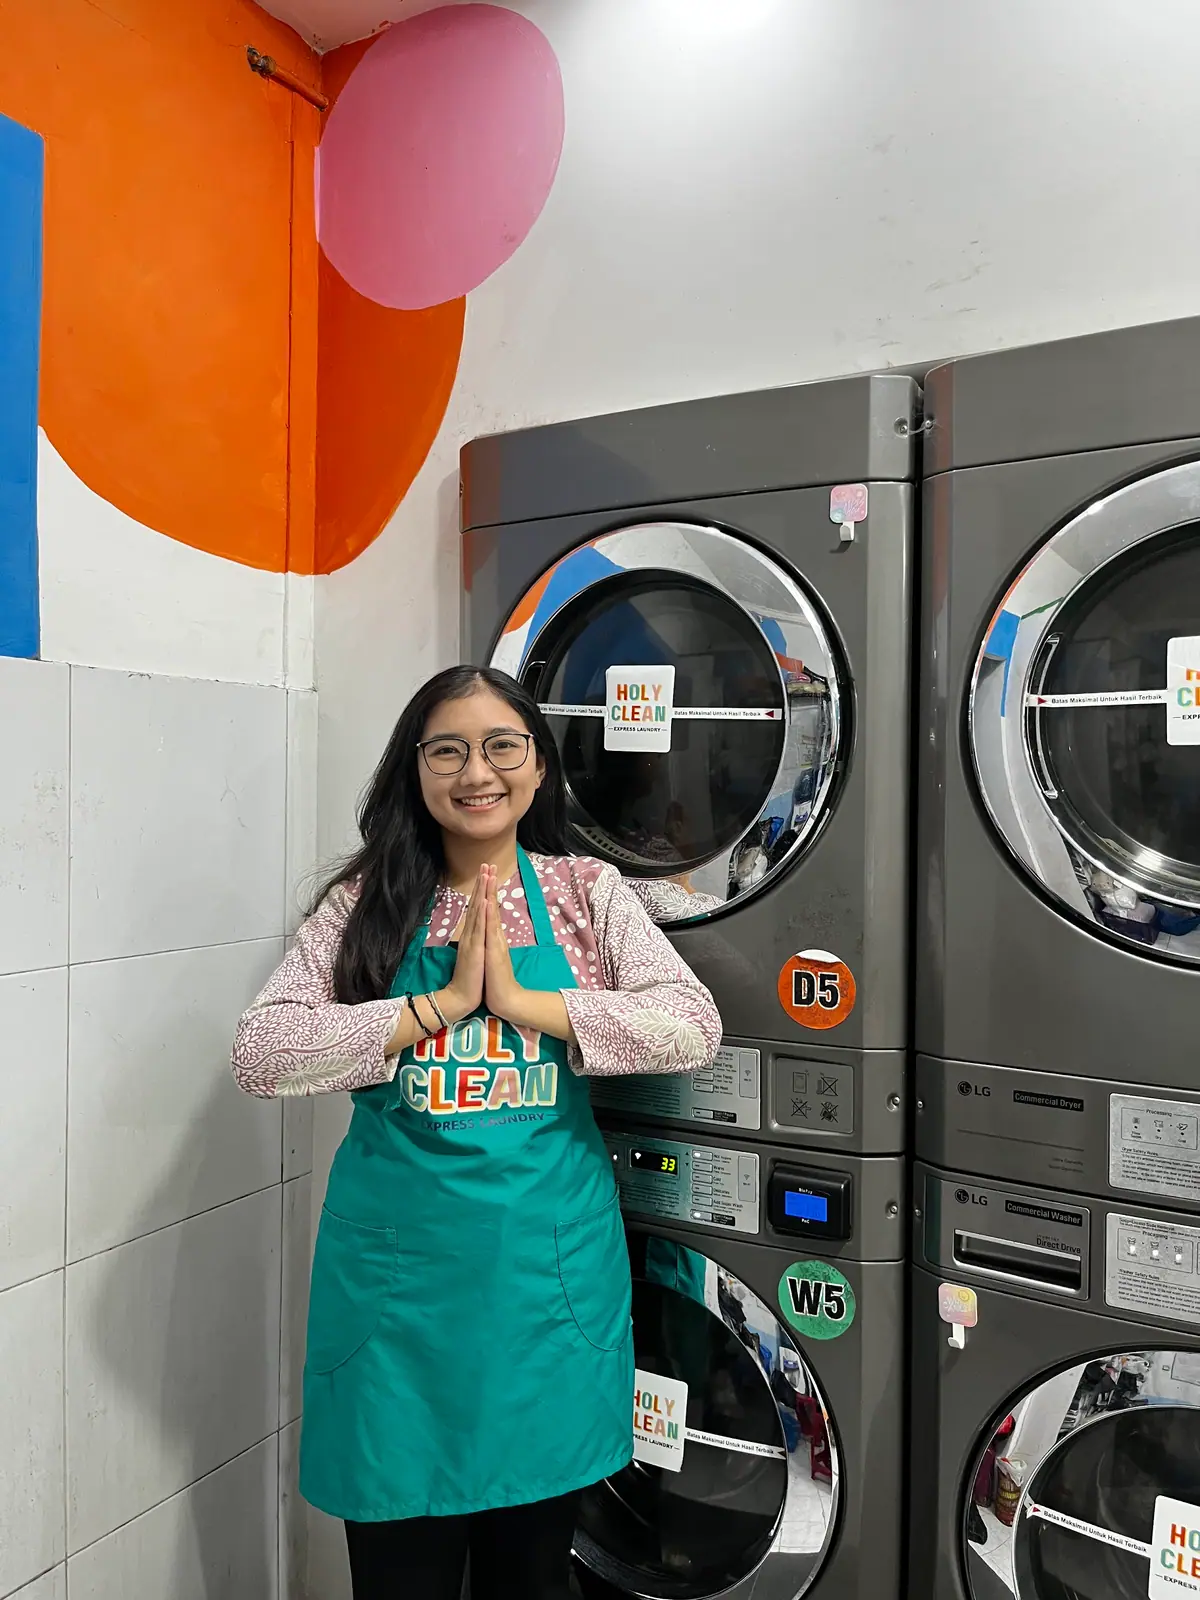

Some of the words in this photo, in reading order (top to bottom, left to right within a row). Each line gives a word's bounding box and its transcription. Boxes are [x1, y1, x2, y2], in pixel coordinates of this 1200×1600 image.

[616, 683, 663, 701] HOLY
[611, 704, 666, 722] CLEAN
[792, 969, 840, 1010] D5
[414, 1016, 542, 1063] HOLY
[400, 1063, 558, 1115] CLEAN
[974, 1085, 991, 1097] LG
[1014, 1092, 1058, 1106] Commercial
[1059, 1099, 1081, 1110] Dryer
[480, 1113, 545, 1128] LAUNDRY
[661, 1157, 676, 1172] 33
[971, 1193, 988, 1206] LG
[1007, 1202, 1050, 1218] Commercial
[1050, 1211, 1081, 1224] Washer
[1036, 1237, 1060, 1249] Direct
[1061, 1243, 1081, 1253] Drive
[787, 1276, 846, 1321] W5
[649, 1438, 674, 1449] LAUNDRY
[701, 1435, 725, 1445] Maksimal
[755, 1446, 774, 1454] Terbaik
[1043, 1510, 1060, 1521] Batas
[1061, 1517, 1088, 1532] Maksimal
[1088, 1528, 1107, 1539] Untuk
[1107, 1534, 1124, 1545] Hasil
[1125, 1540, 1147, 1553] Terbaik
[1170, 1523, 1200, 1551] HO
[1163, 1575, 1198, 1591] EXPRESS
